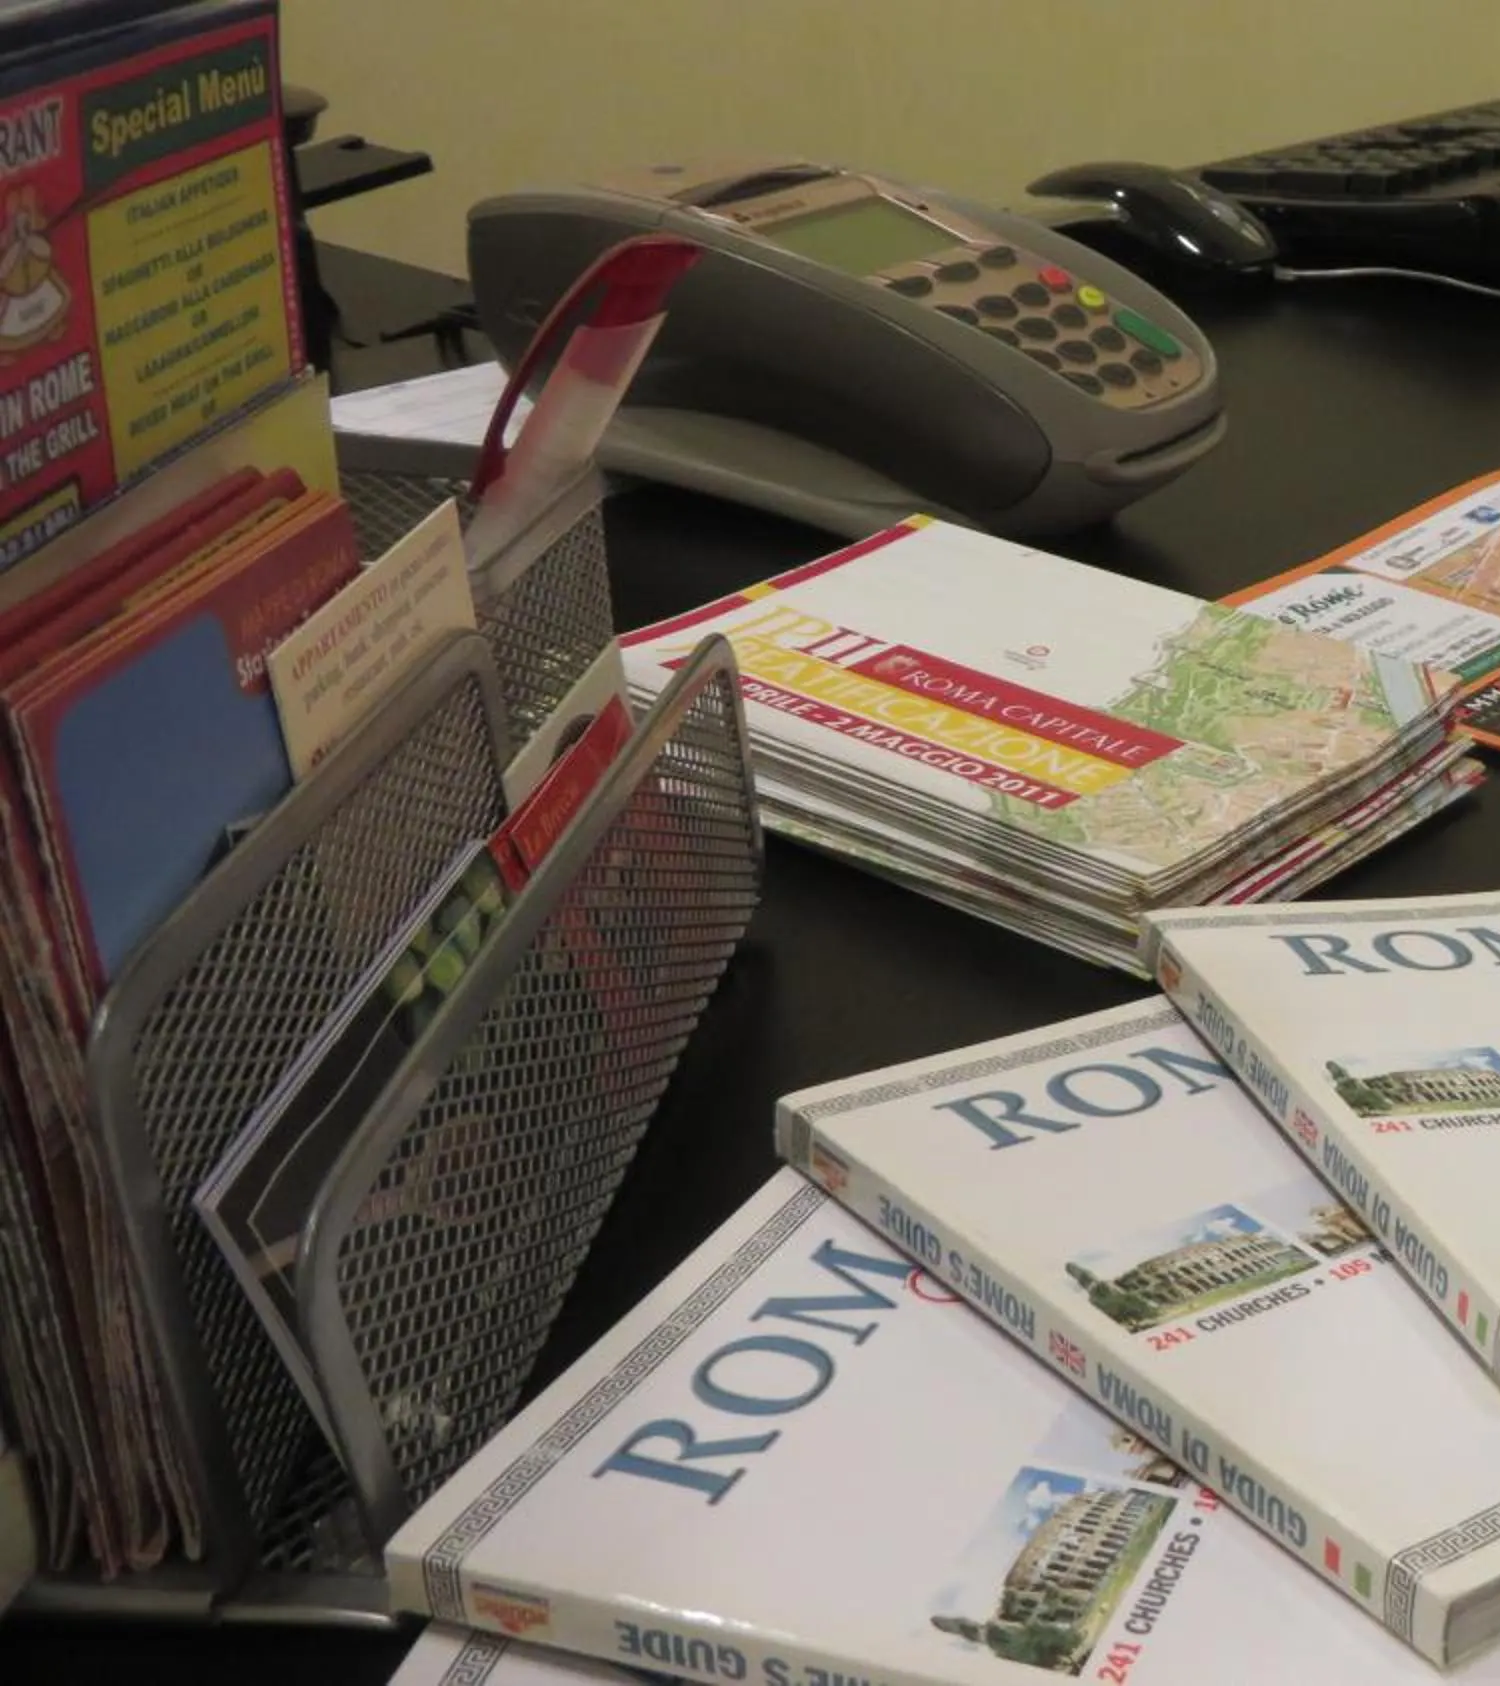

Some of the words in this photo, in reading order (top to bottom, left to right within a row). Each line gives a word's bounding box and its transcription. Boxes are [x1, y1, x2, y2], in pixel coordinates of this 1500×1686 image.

[92, 80, 191, 157] Special
[197, 57, 267, 114] Menù
[29, 351, 95, 422] ROME
[6, 446, 42, 483] THE
[46, 410, 99, 459] GRILL
[742, 680, 819, 716] PRILE
[829, 712, 852, 730] 2
[853, 718, 985, 777] MAGGIO
[981, 767, 1061, 803] 2011
[901, 669, 1000, 711] ROMA
[1001, 705, 1149, 760] CAPITALE
[932, 1046, 1240, 1151] ROM
[1370, 1118, 1413, 1135] 241
[1322, 1133, 1371, 1210] ROMA
[1373, 1191, 1391, 1234] DI
[878, 1193, 942, 1273] GUIDE
[1393, 1214, 1450, 1299] GUIDA
[948, 1249, 1036, 1341] ROME'S
[1146, 1326, 1196, 1352] 241
[1195, 1282, 1312, 1334] CHURCHES
[1328, 1257, 1374, 1282] 105
[590, 1238, 923, 1508] ROM
[1097, 1362, 1172, 1448] ROMA
[1182, 1428, 1209, 1474] DI
[1218, 1455, 1308, 1549] GUIDA
[614, 1618, 746, 1681] GUIDE
[1097, 1641, 1144, 1685] 241
[1124, 1530, 1201, 1636] CHURCHES
